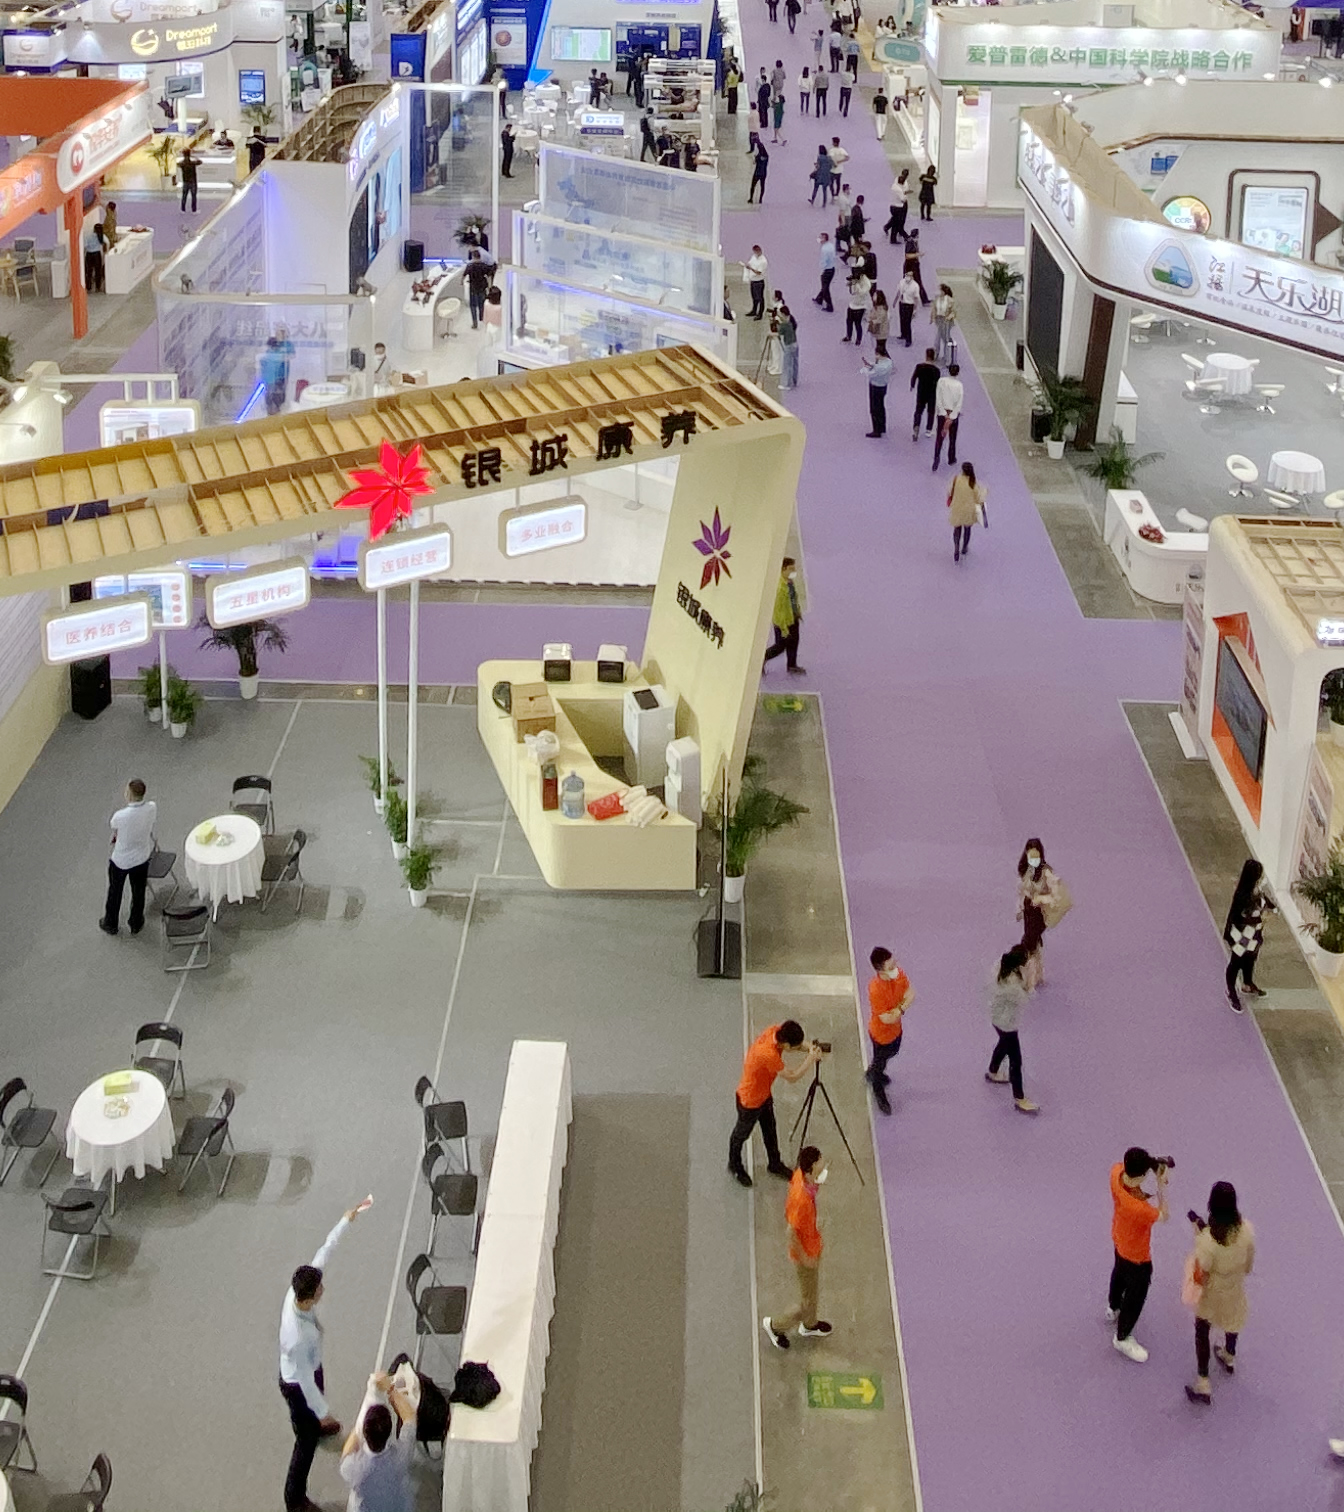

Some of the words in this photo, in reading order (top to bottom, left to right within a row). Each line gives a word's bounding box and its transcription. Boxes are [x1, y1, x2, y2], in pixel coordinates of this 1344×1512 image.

[140, 1, 198, 16] Dreamport
[165, 22, 218, 42] Dreamport
[967, 43, 1254, 72] 爱普雷德&中国科学院战略合作
[459, 408, 700, 490] 银城康养
[519, 519, 575, 544] 多业融合
[380, 548, 440, 577] 连锁经营
[228, 582, 293, 611] 五星机构
[64, 617, 135, 647] 医养结合
